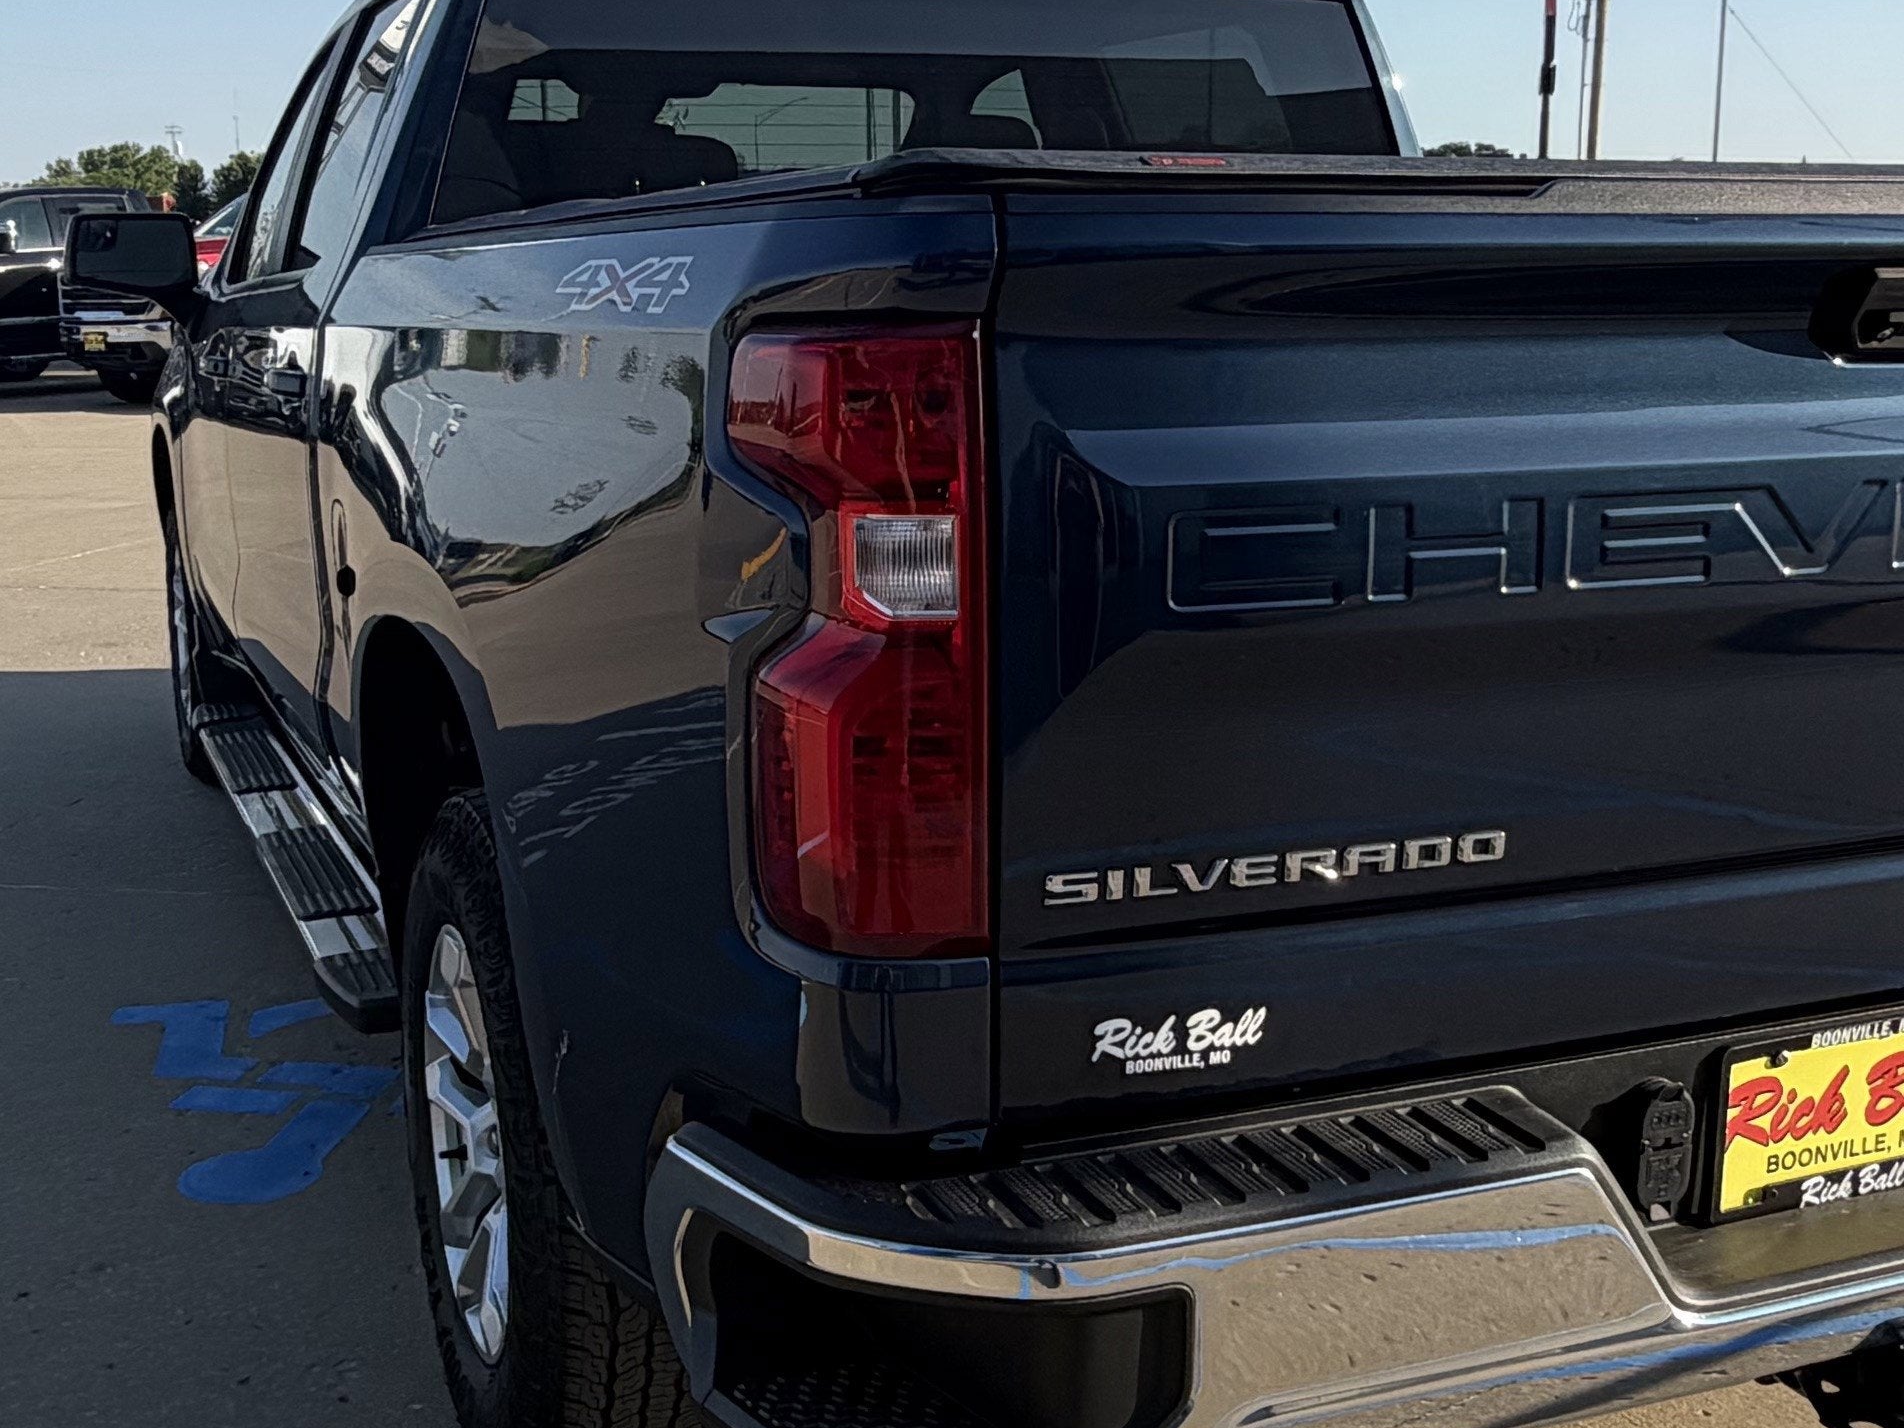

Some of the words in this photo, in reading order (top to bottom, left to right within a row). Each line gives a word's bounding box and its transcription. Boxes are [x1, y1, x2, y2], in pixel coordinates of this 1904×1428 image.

[1043, 829, 1506, 907] SILVERADO
[1091, 1015, 1177, 1064] Rick
[1185, 1005, 1268, 1058] Ball
[1810, 1019, 1895, 1049] BOONVILLE,
[1124, 1052, 1206, 1075] BOONVILLE,
[1208, 1048, 1232, 1066] MO
[1724, 1064, 1851, 1153] Rick
[1765, 1131, 1892, 1174] BOONVILLE,
[1799, 1170, 1854, 1209] Rick
